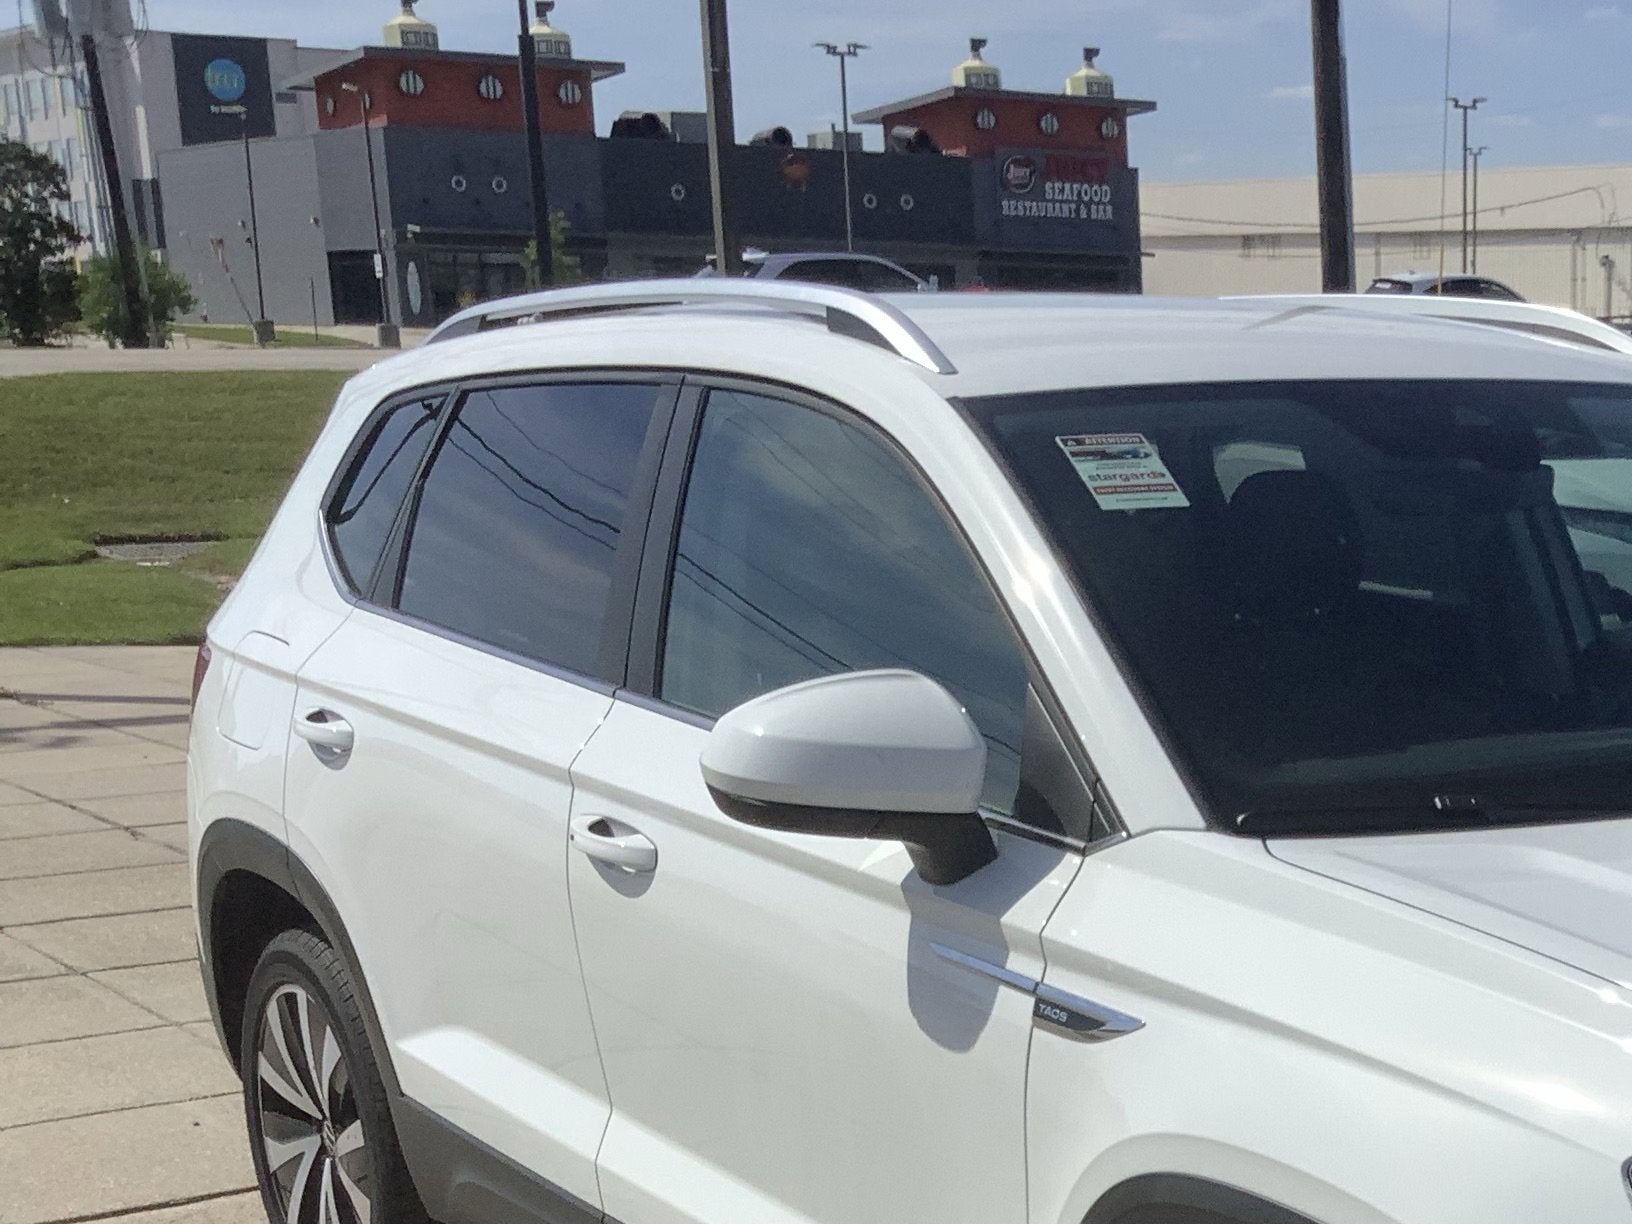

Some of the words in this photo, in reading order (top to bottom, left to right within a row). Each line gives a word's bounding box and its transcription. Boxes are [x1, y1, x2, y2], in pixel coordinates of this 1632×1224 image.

[1045, 182, 1111, 202] SEAFOOD
[1001, 200, 1077, 217] RESTAURANT
[1080, 203, 1087, 219] &
[1090, 204, 1113, 220] BAR
[1039, 1004, 1068, 1022] TAOS
